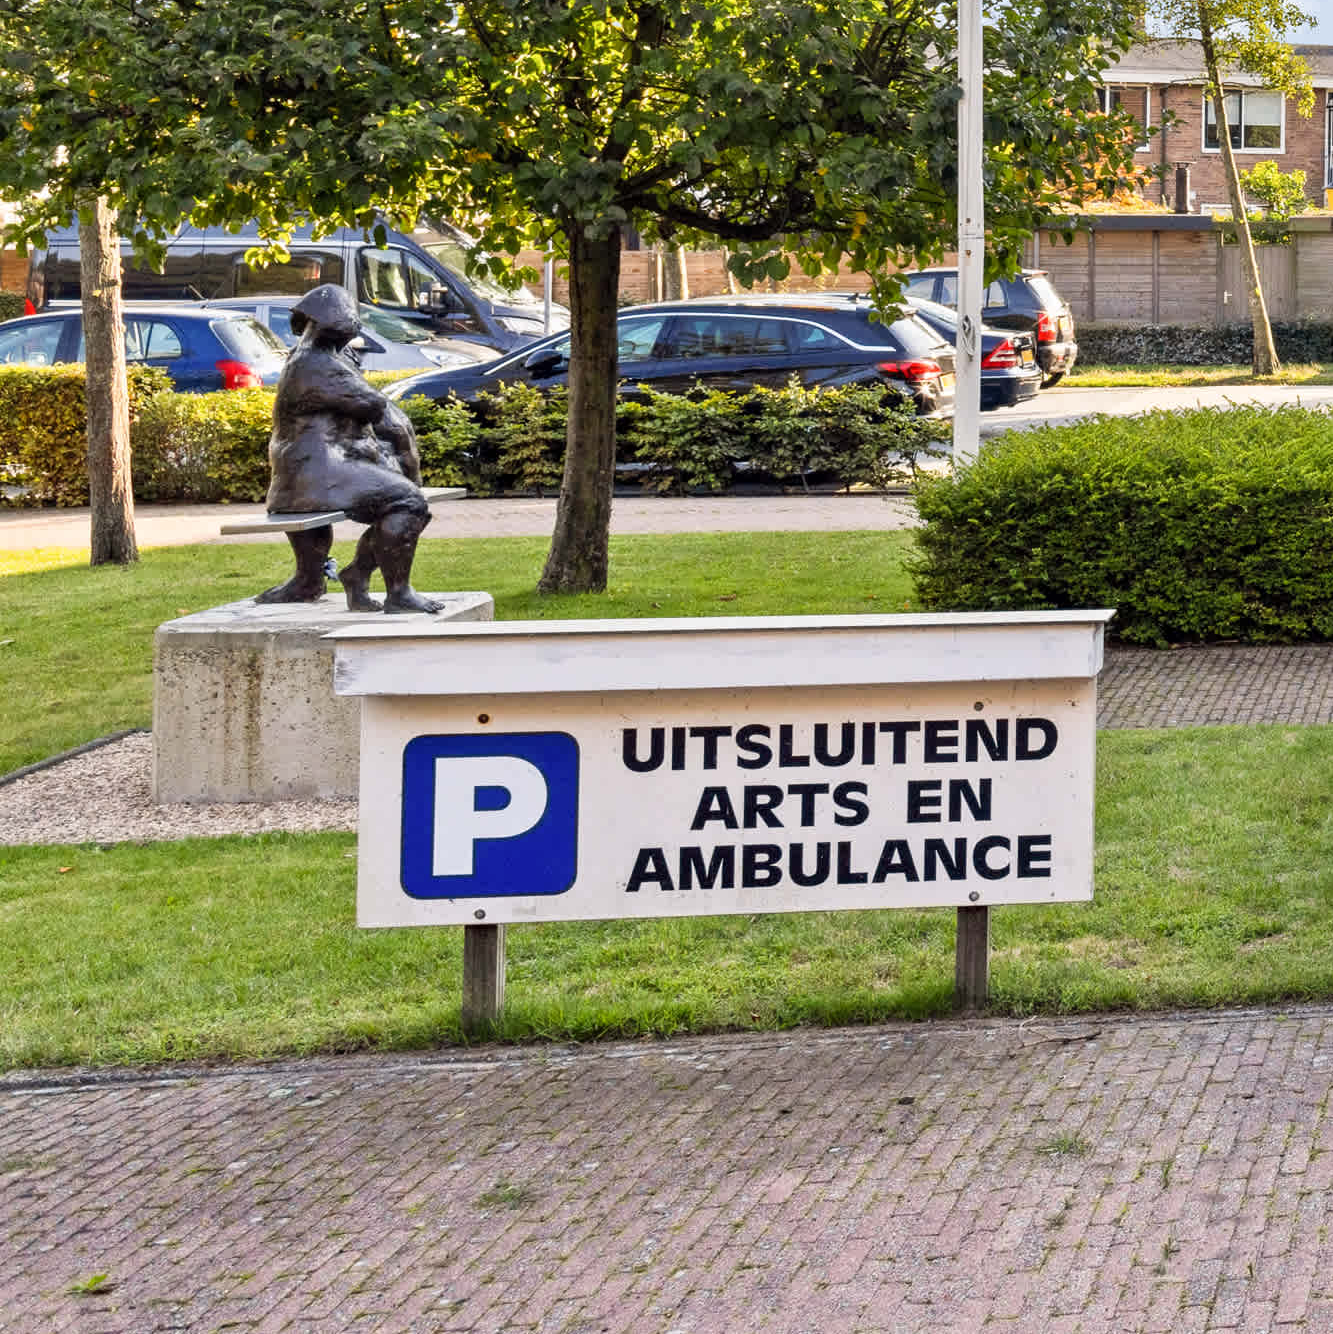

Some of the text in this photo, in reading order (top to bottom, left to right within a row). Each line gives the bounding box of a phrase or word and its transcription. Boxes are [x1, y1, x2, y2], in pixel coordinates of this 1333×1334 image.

[621, 716, 1059, 773] UITSLUITEND
[432, 755, 548, 877] P
[690, 777, 993, 832] ARTS EN
[625, 833, 1053, 893] AMBULANCE
